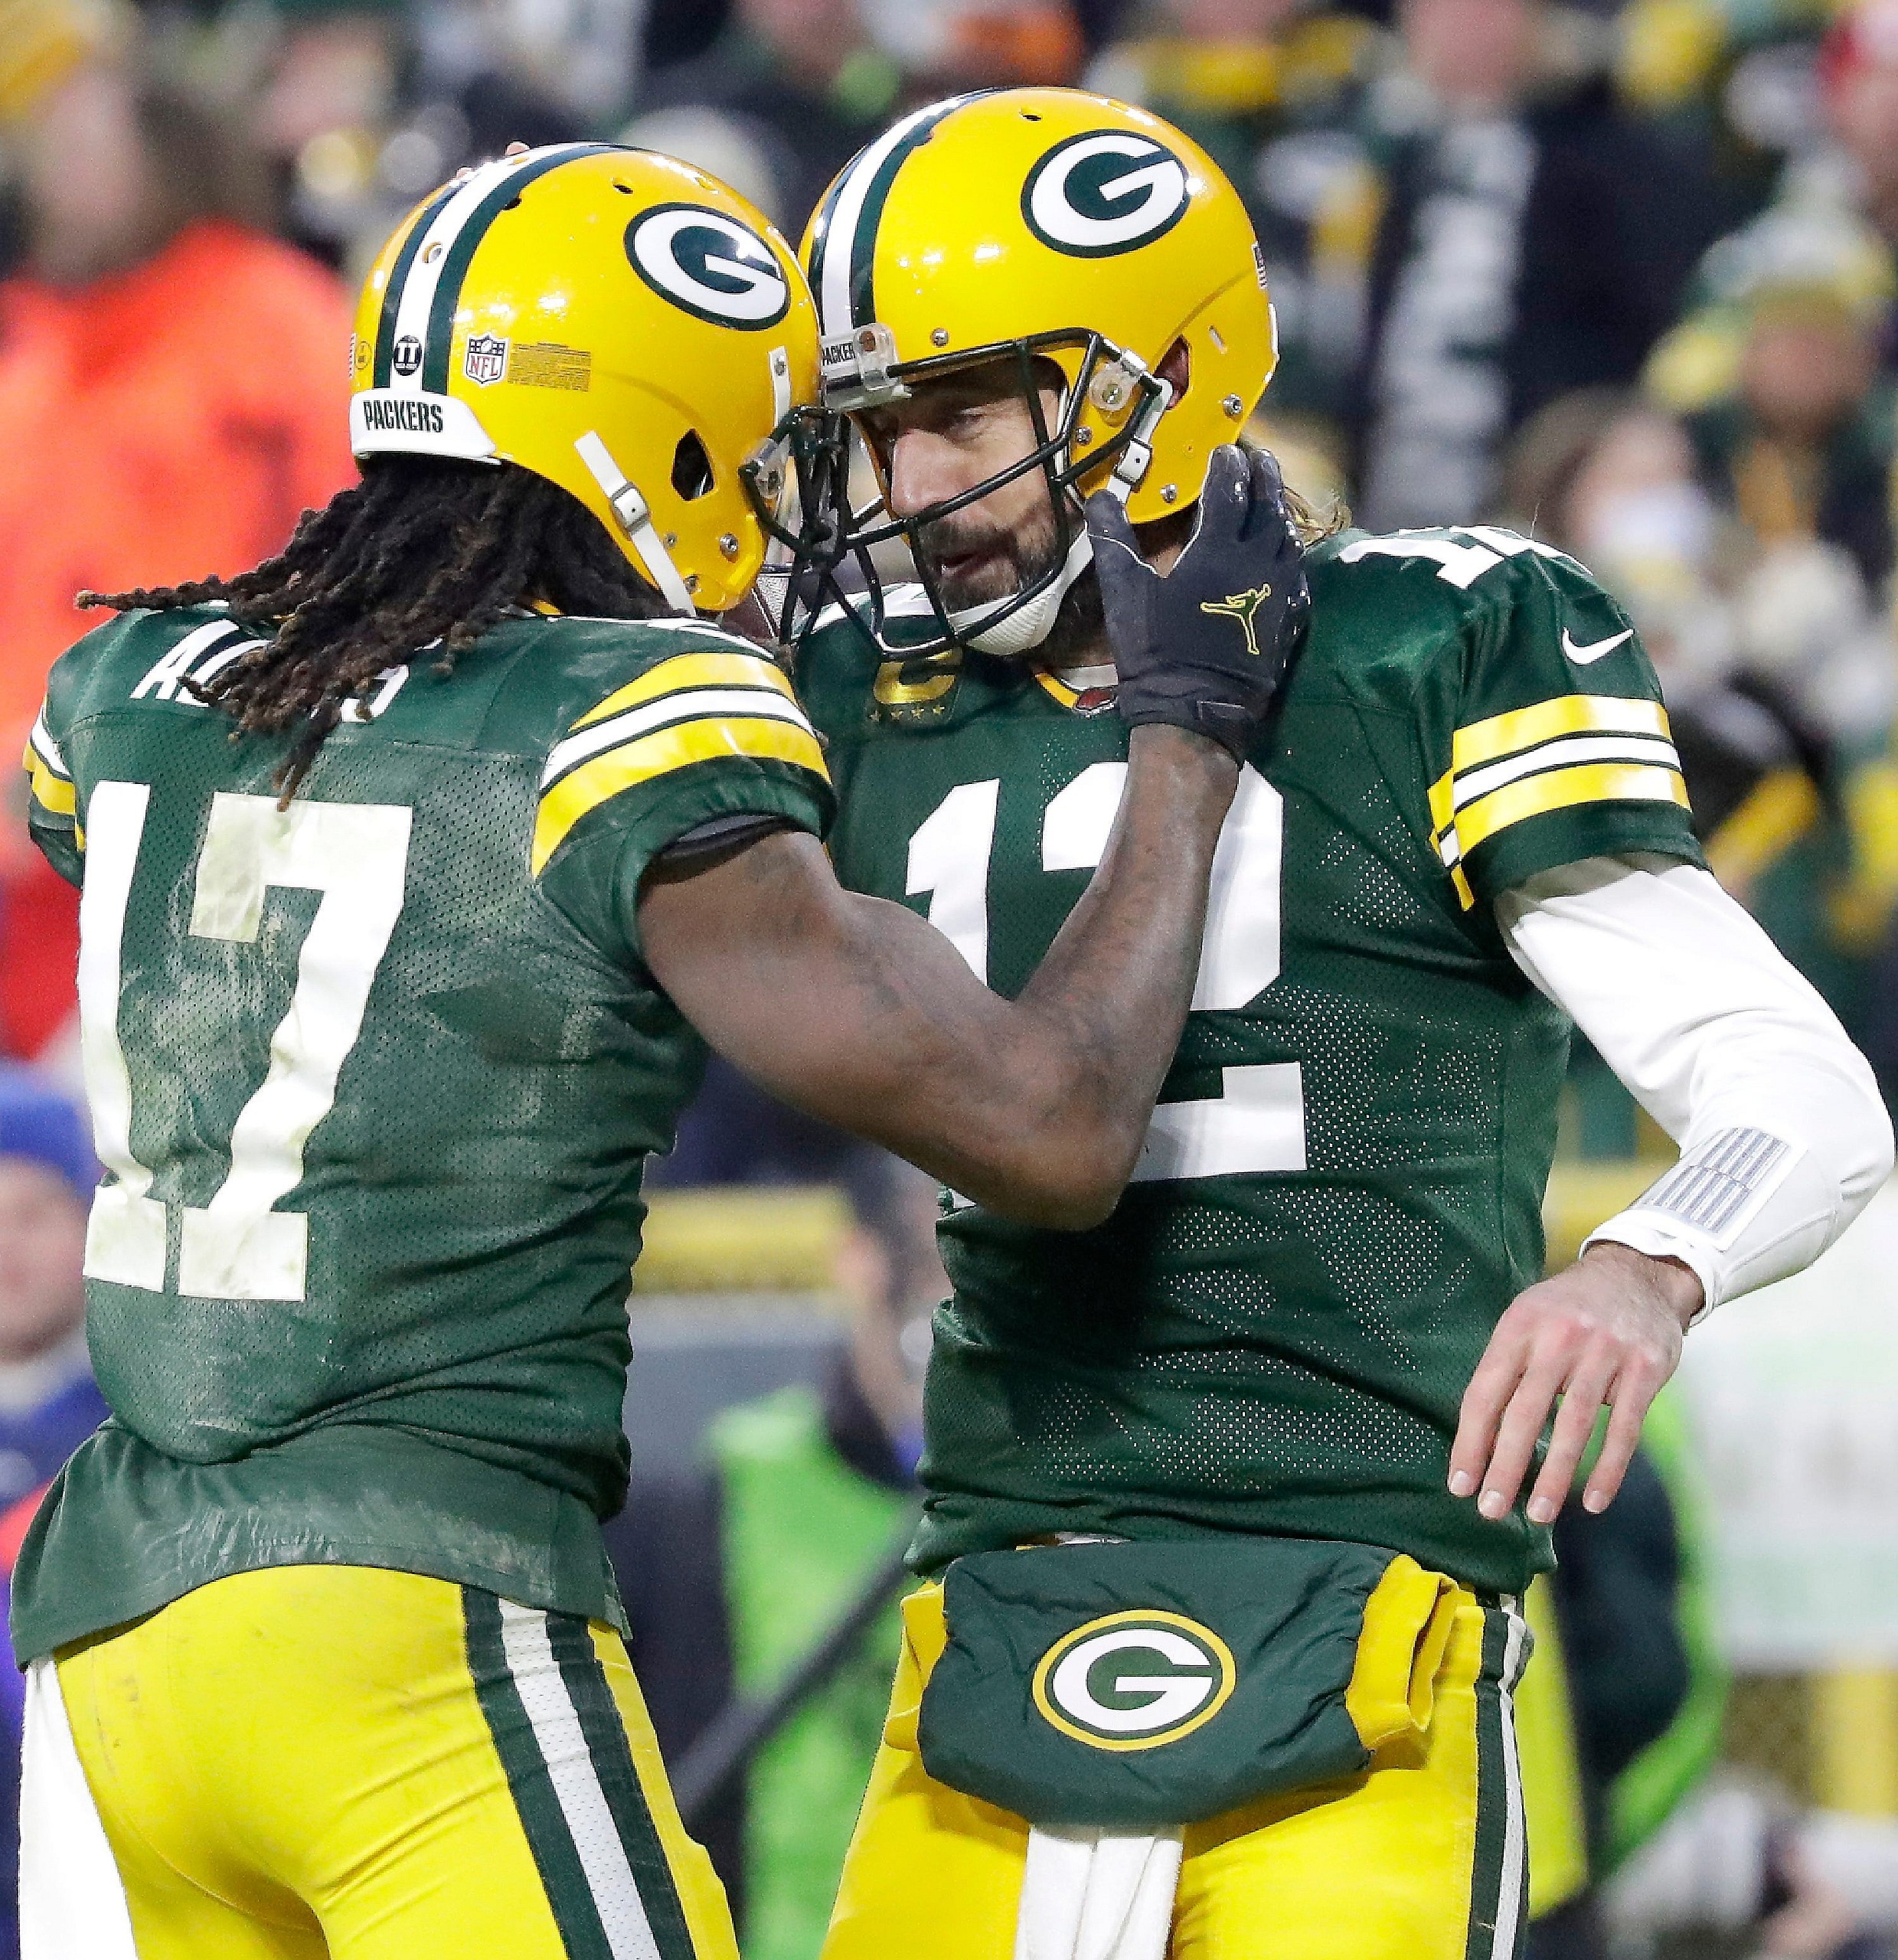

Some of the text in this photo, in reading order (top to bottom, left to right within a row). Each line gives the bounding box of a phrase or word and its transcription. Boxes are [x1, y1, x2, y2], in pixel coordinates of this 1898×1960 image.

[1031, 134, 1184, 247] G
[634, 210, 786, 320] G
[469, 354, 498, 378] NFL
[822, 342, 856, 366] PACKER
[364, 400, 443, 433] PACKERS
[77, 780, 413, 1302] 17
[1053, 1628, 1213, 1732] G
